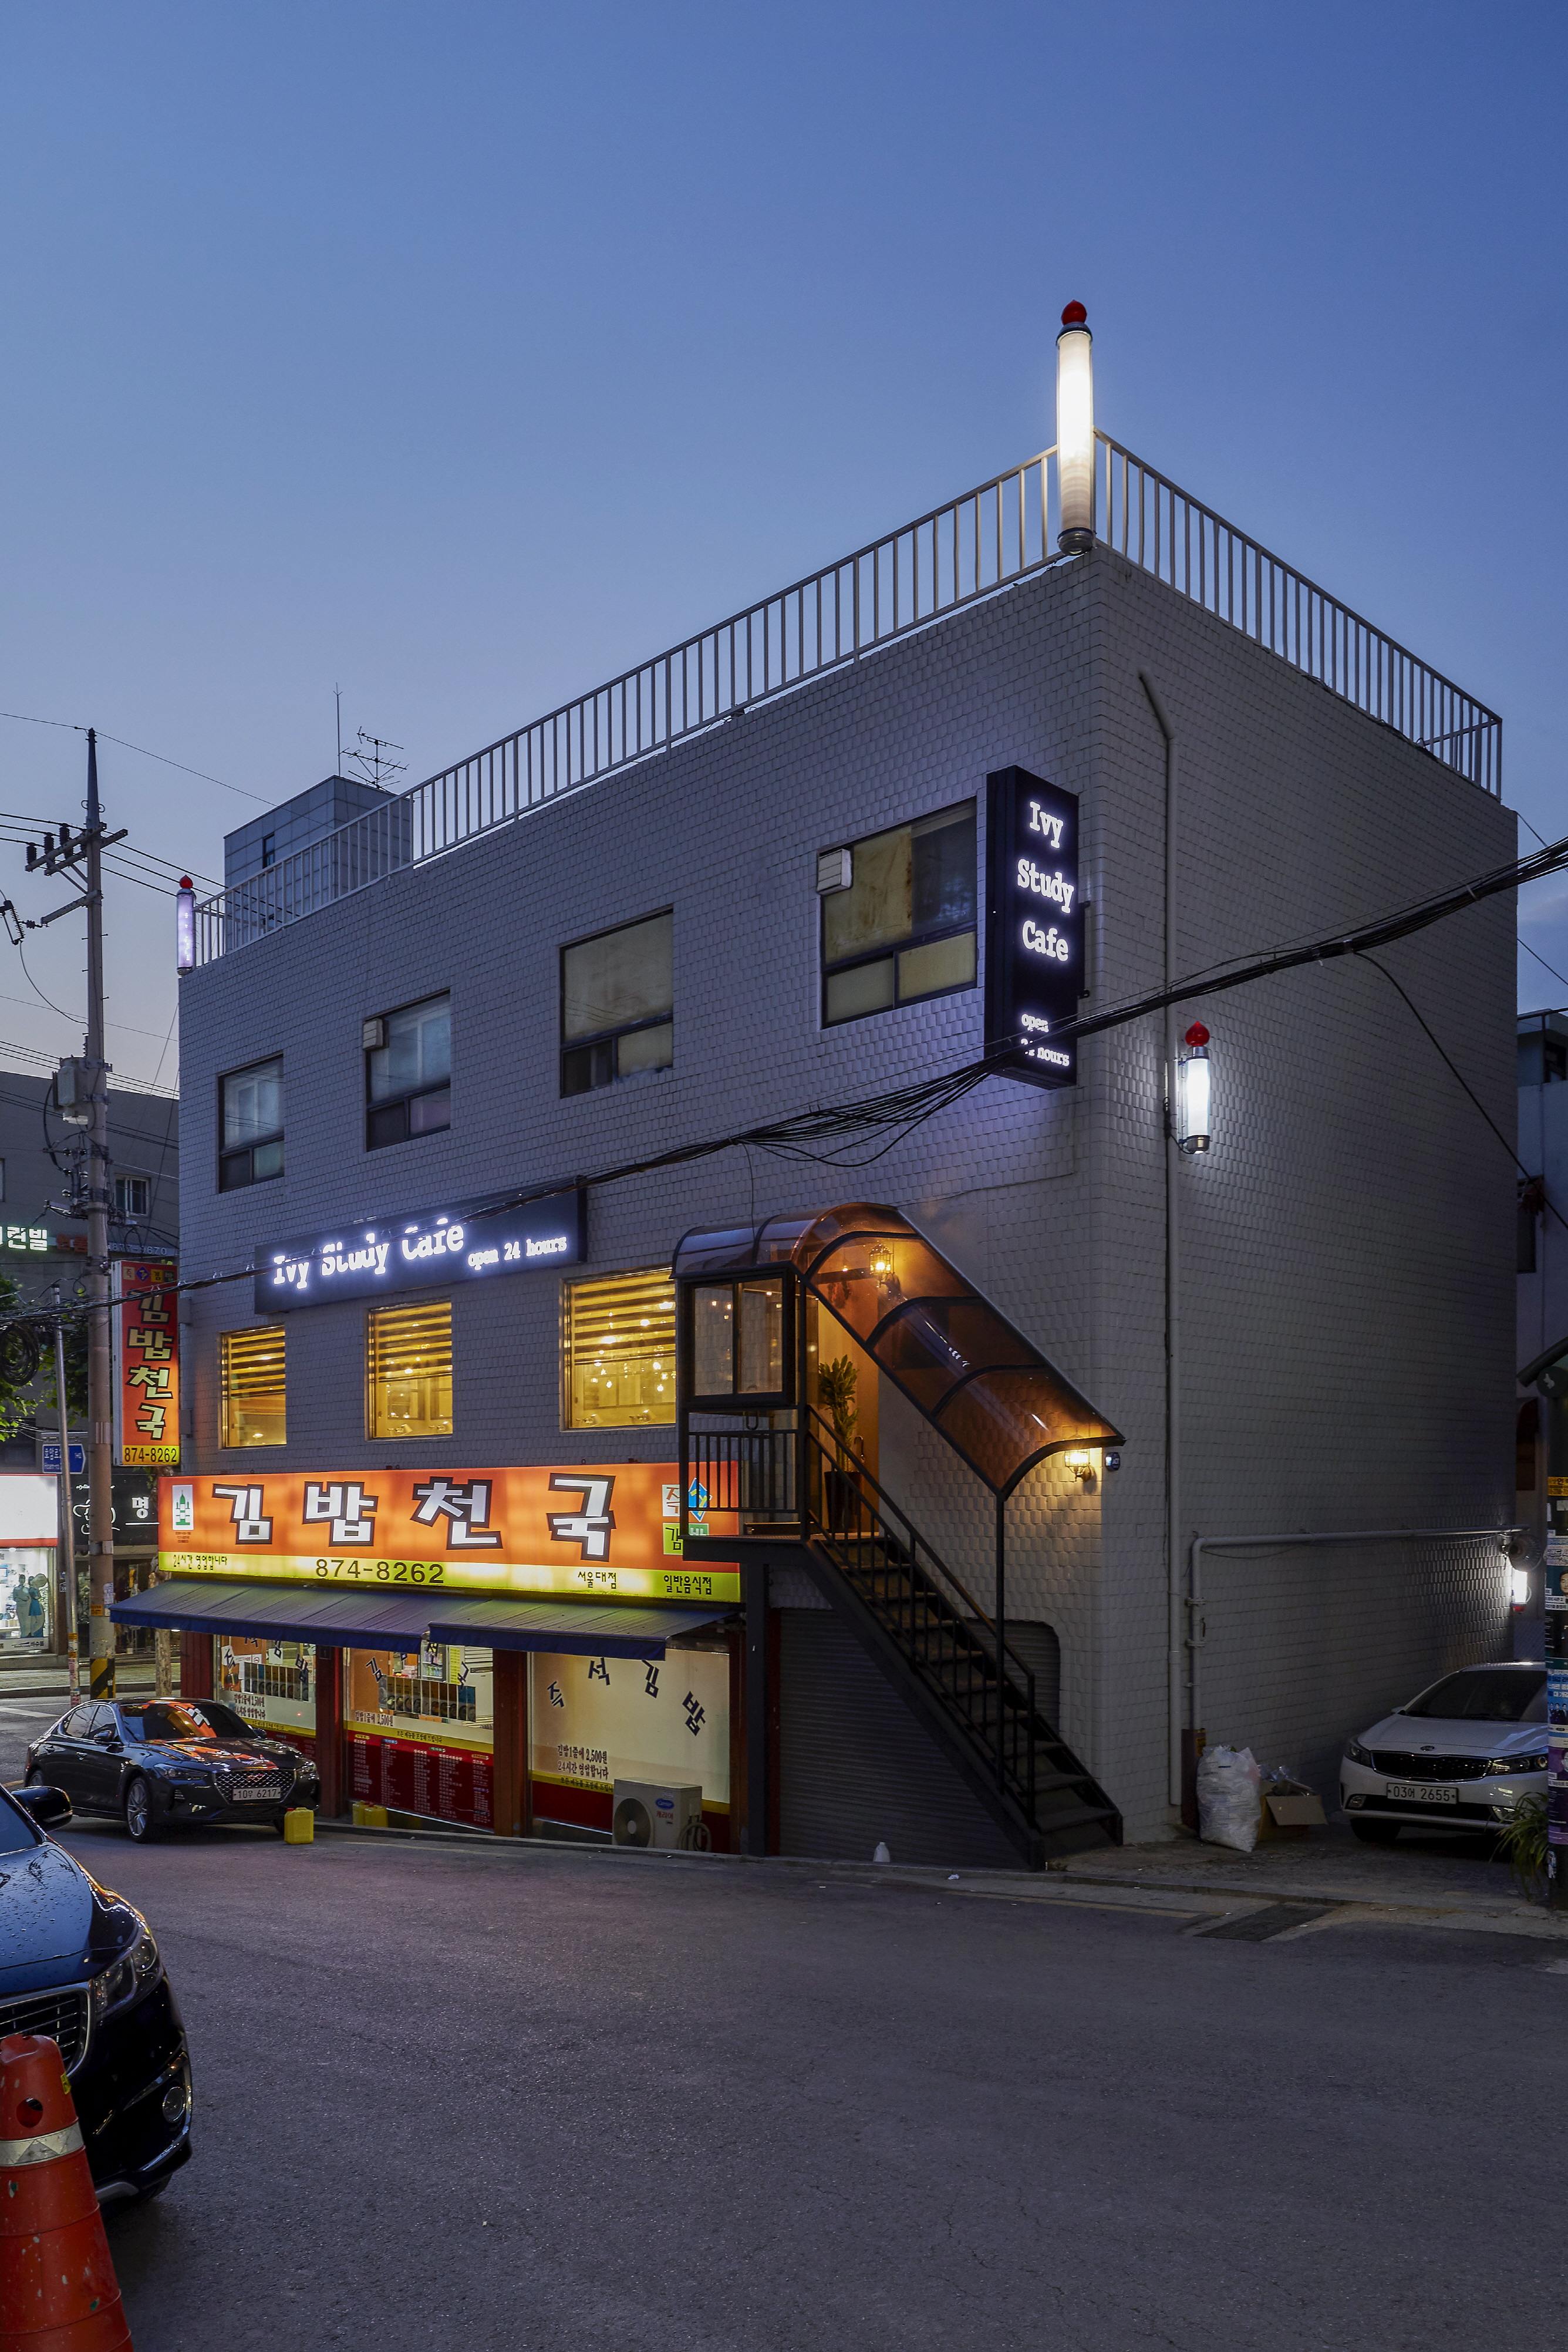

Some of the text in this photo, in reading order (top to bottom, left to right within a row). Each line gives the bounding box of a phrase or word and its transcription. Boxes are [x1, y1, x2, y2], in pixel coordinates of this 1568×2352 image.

[1030, 801, 1063, 848] Ivy
[1017, 858, 1074, 914] Study
[1022, 920, 1068, 962] Cafe
[1021, 1013, 1048, 1033] open
[273, 1255, 309, 1289] Ivy
[468, 1248, 499, 1271] open
[504, 1242, 521, 1261] 24
[526, 1234, 567, 1256] hours
[126, 1289, 175, 1441] 김밥천국
[124, 1447, 177, 1463] 874-8262
[212, 1472, 616, 1562] 김밥천국
[173, 1554, 228, 1571] 24시간 영업합니다
[315, 1558, 444, 1584] 874-8262
[577, 1571, 618, 1590] 서울대점
[663, 1574, 713, 1596] 일반음식점
[557, 1744, 608, 1764] 김밥1줄에 2,500원
[557, 1760, 609, 1780] 24시간 영업합니다
[257, 1788, 277, 1798] 6217
[599, 1784, 613, 1792] 드립니
[1420, 1788, 1450, 1802] 2655
